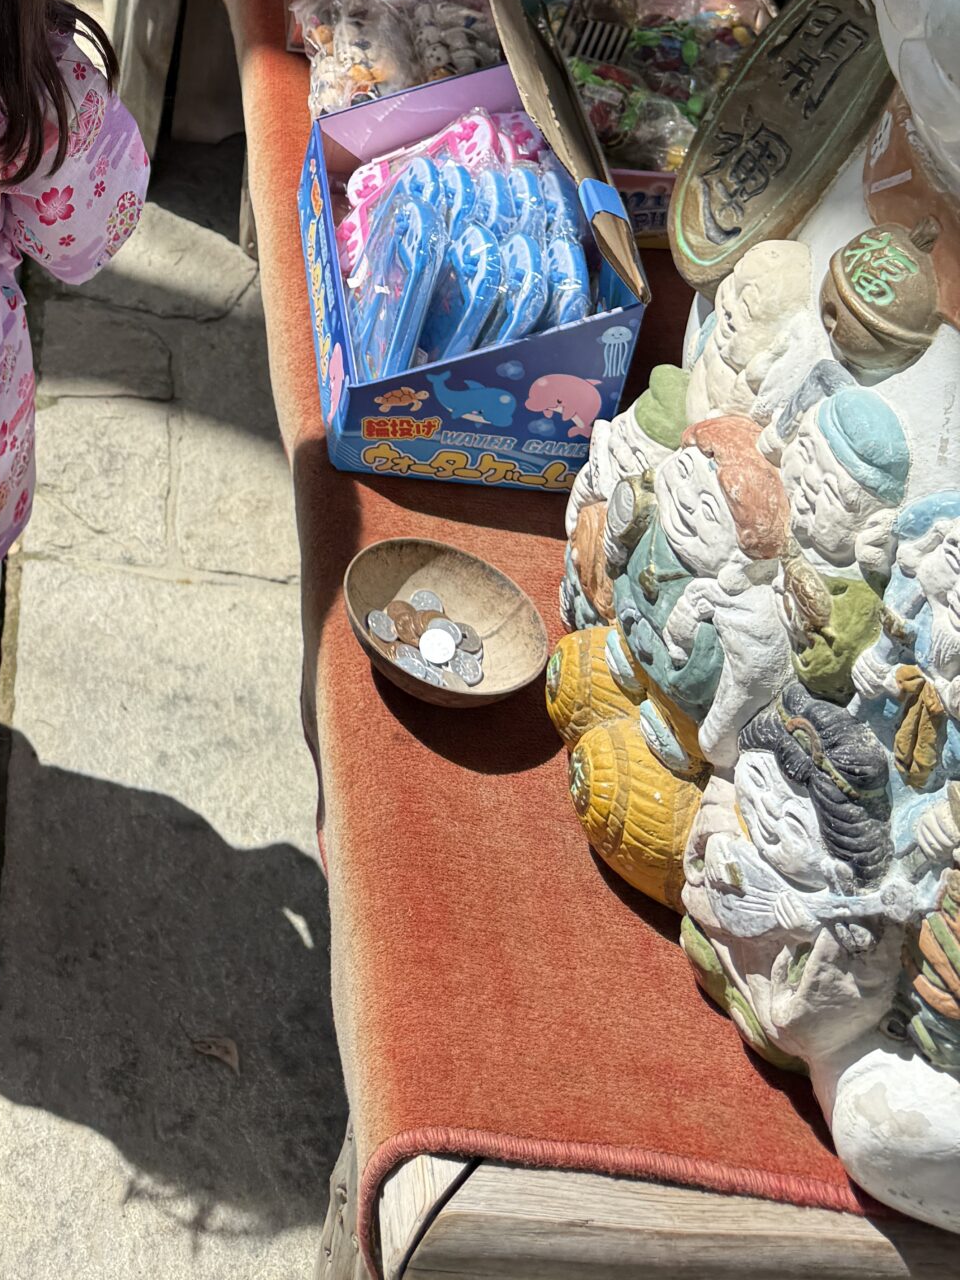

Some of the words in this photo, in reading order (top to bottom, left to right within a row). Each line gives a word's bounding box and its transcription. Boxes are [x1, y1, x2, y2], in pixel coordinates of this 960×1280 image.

[843, 231, 920, 307] 福
[361, 416, 442, 440] 輪投げ
[440, 430, 516, 452] WATER
[521, 439, 591, 458] GAME
[360, 441, 577, 492] ウォーターゲーム
